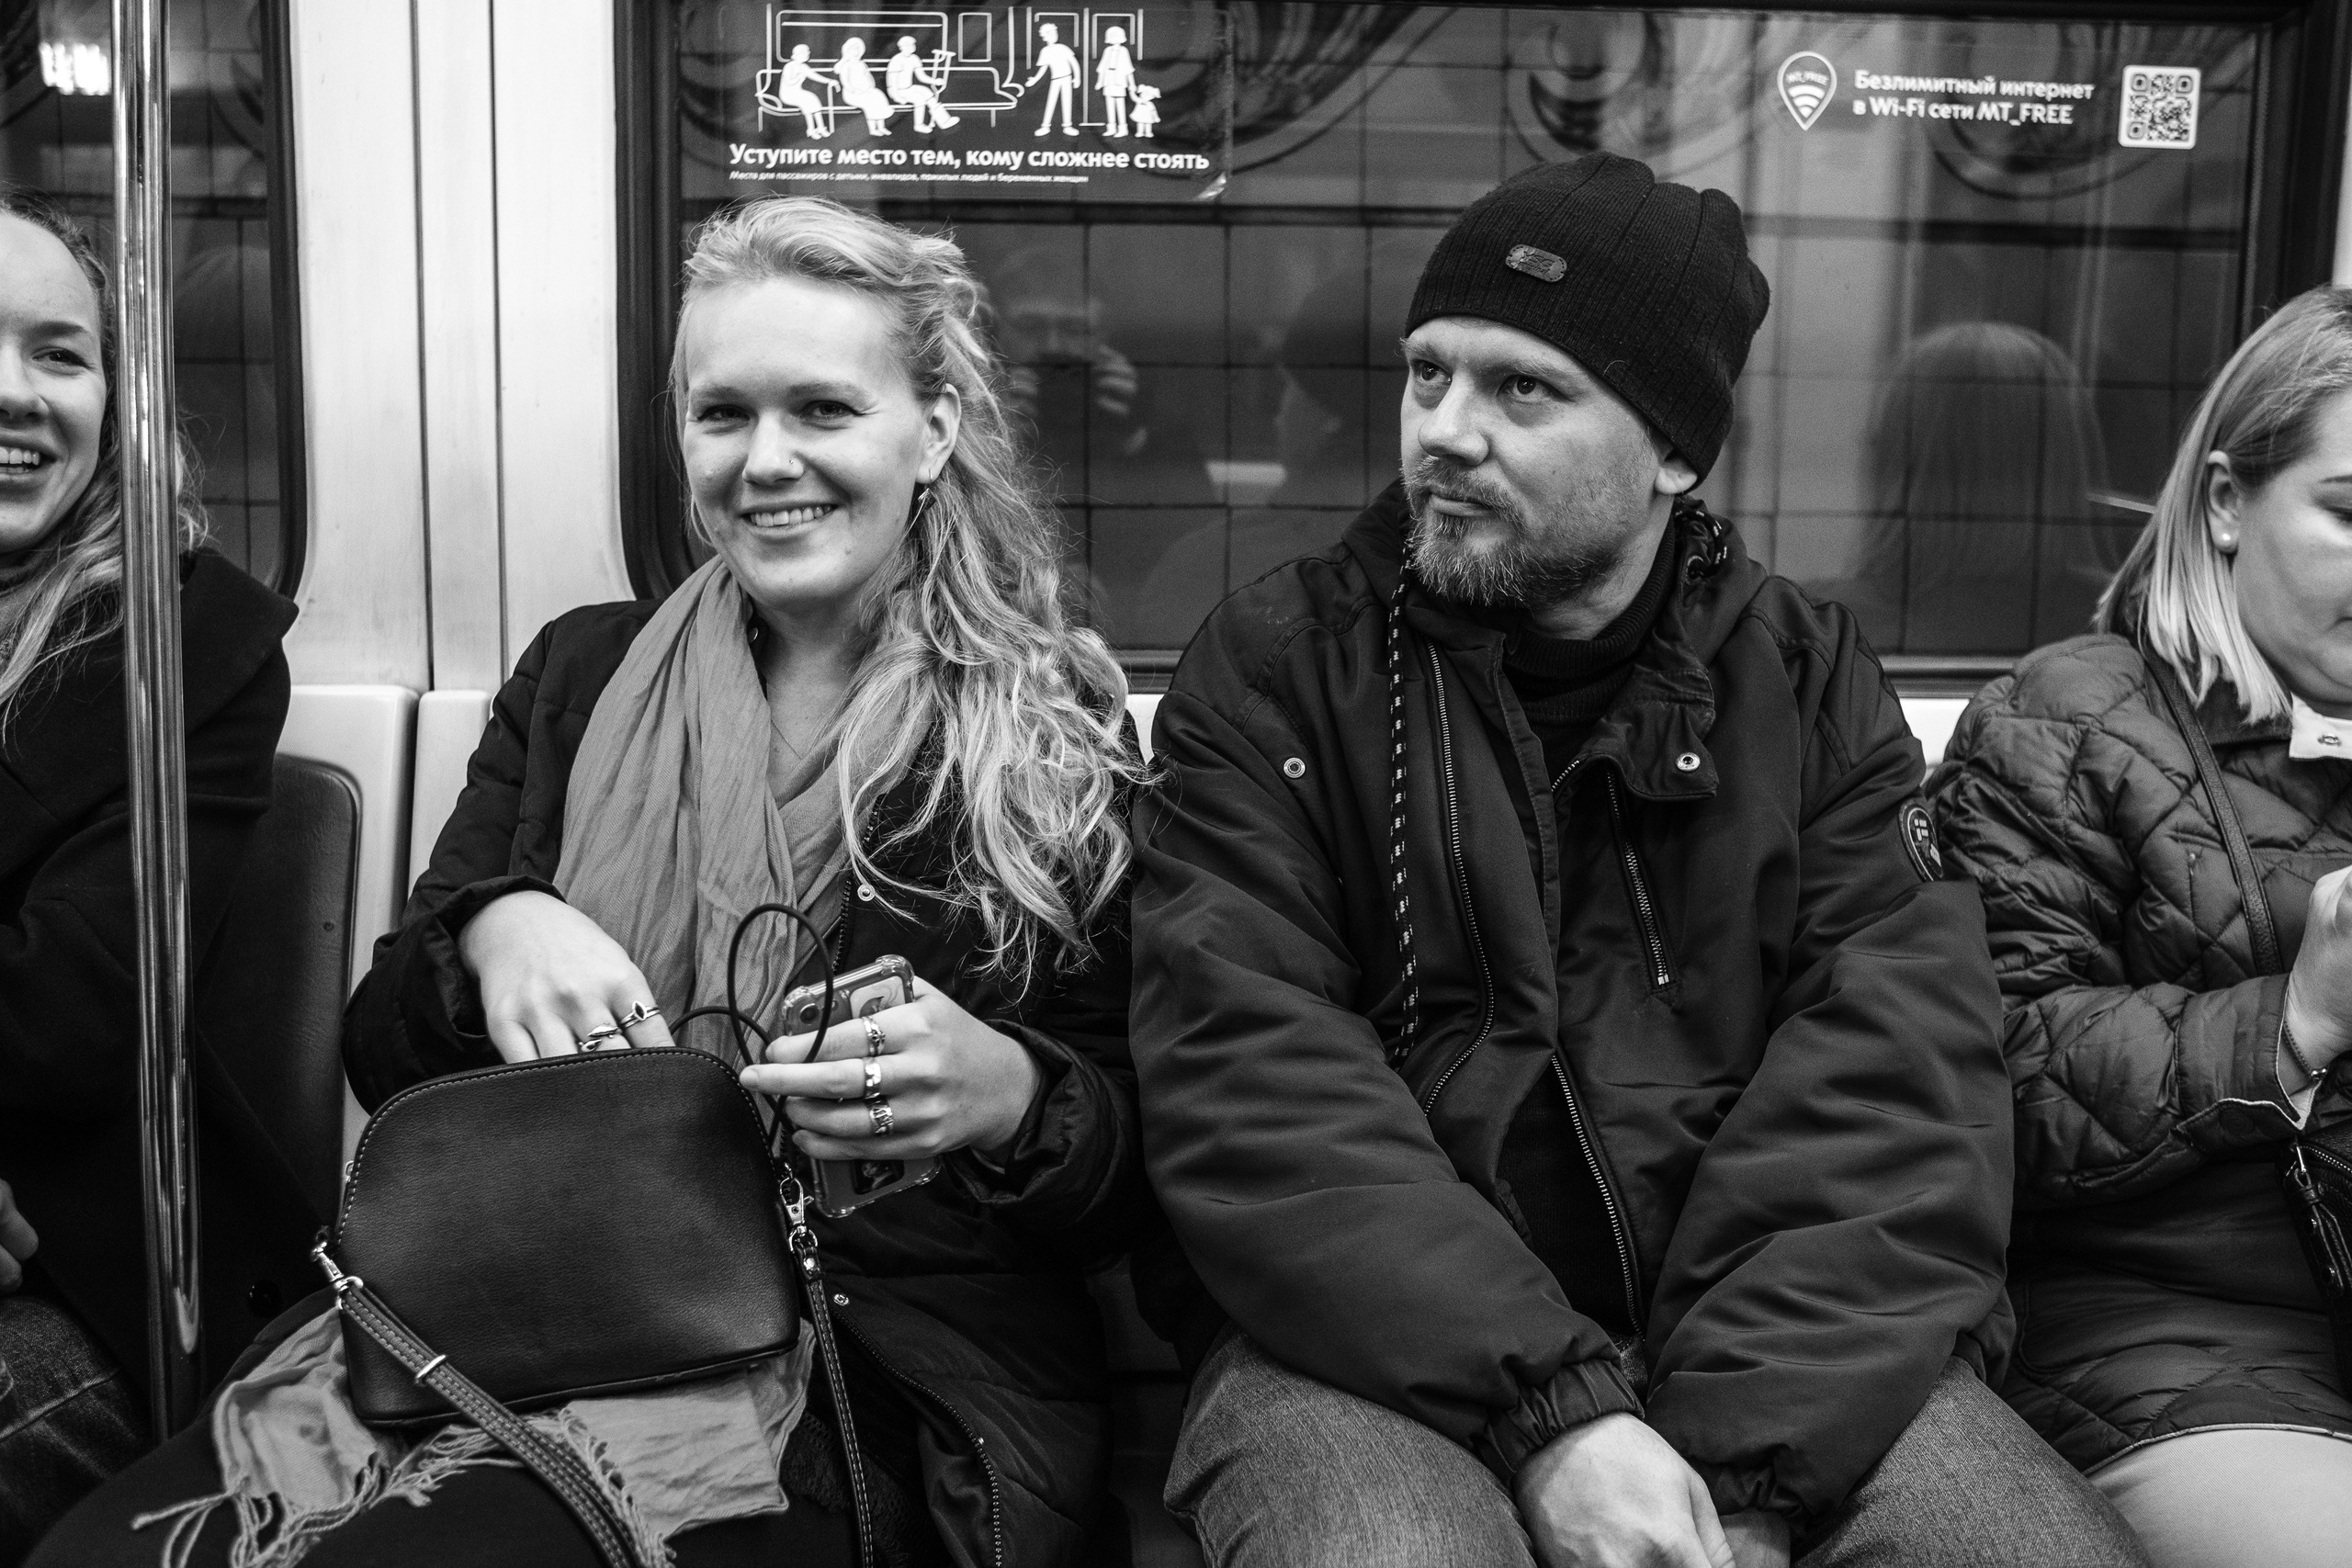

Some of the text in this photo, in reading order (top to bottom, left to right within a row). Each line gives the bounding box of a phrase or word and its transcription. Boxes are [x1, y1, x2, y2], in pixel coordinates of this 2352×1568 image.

[1854, 69, 2096, 102] Безлимитный интернет
[1852, 96, 2075, 127] в Wi-Fi сети MT_FREE
[729, 143, 1210, 171] Уступите место тем, кому сложнее стоять
